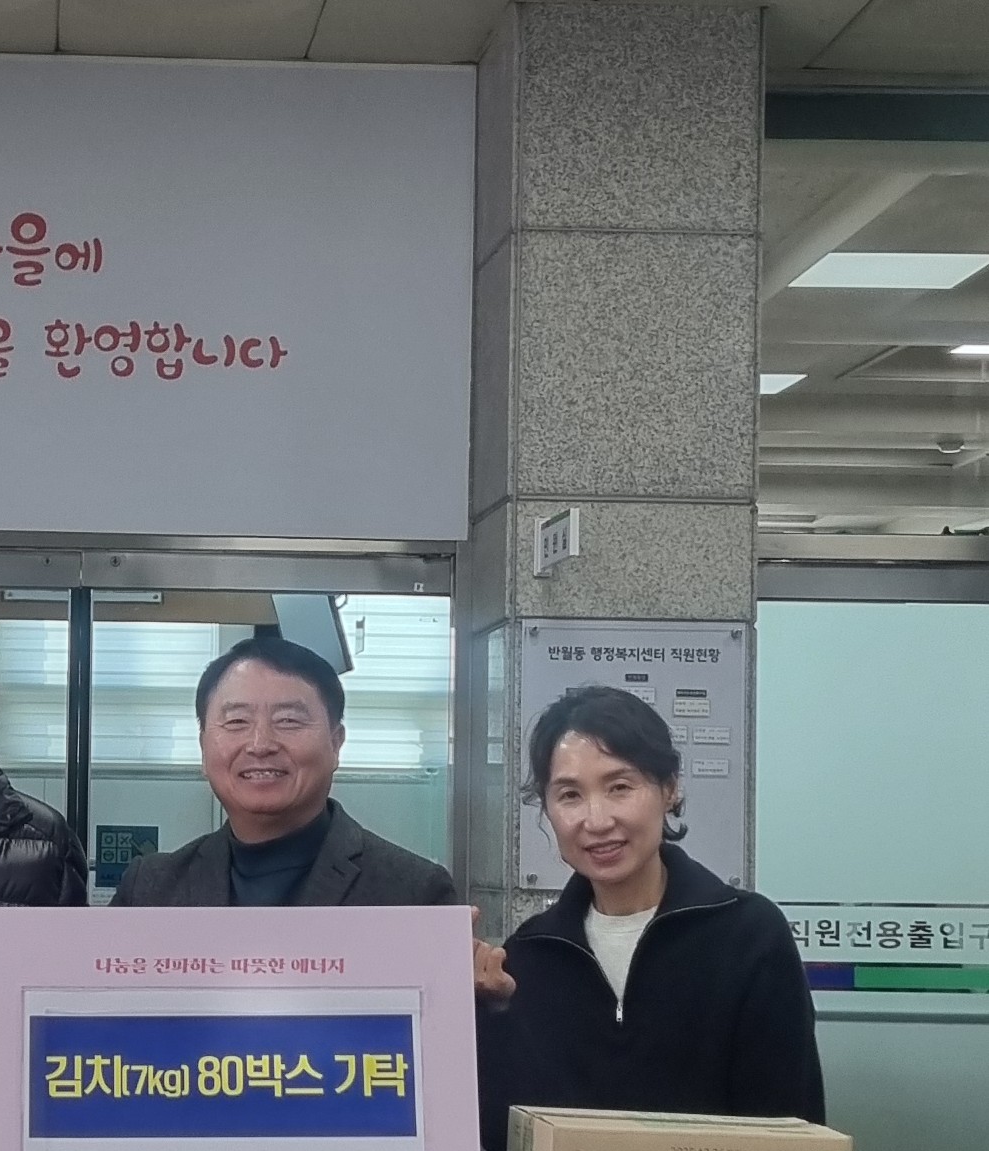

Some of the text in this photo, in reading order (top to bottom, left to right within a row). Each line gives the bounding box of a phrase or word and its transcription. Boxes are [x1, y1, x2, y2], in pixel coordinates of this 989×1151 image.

[44, 318, 288, 380] 환영합니다
[548, 646, 721, 663] 반월동 행정복지센터 직원현황
[95, 957, 147, 974] 나눔을
[231, 958, 285, 974] 따뜻한
[291, 958, 345, 974] 에너지
[45, 1053, 409, 1098] 김치(7kg) 80박스 기탁
